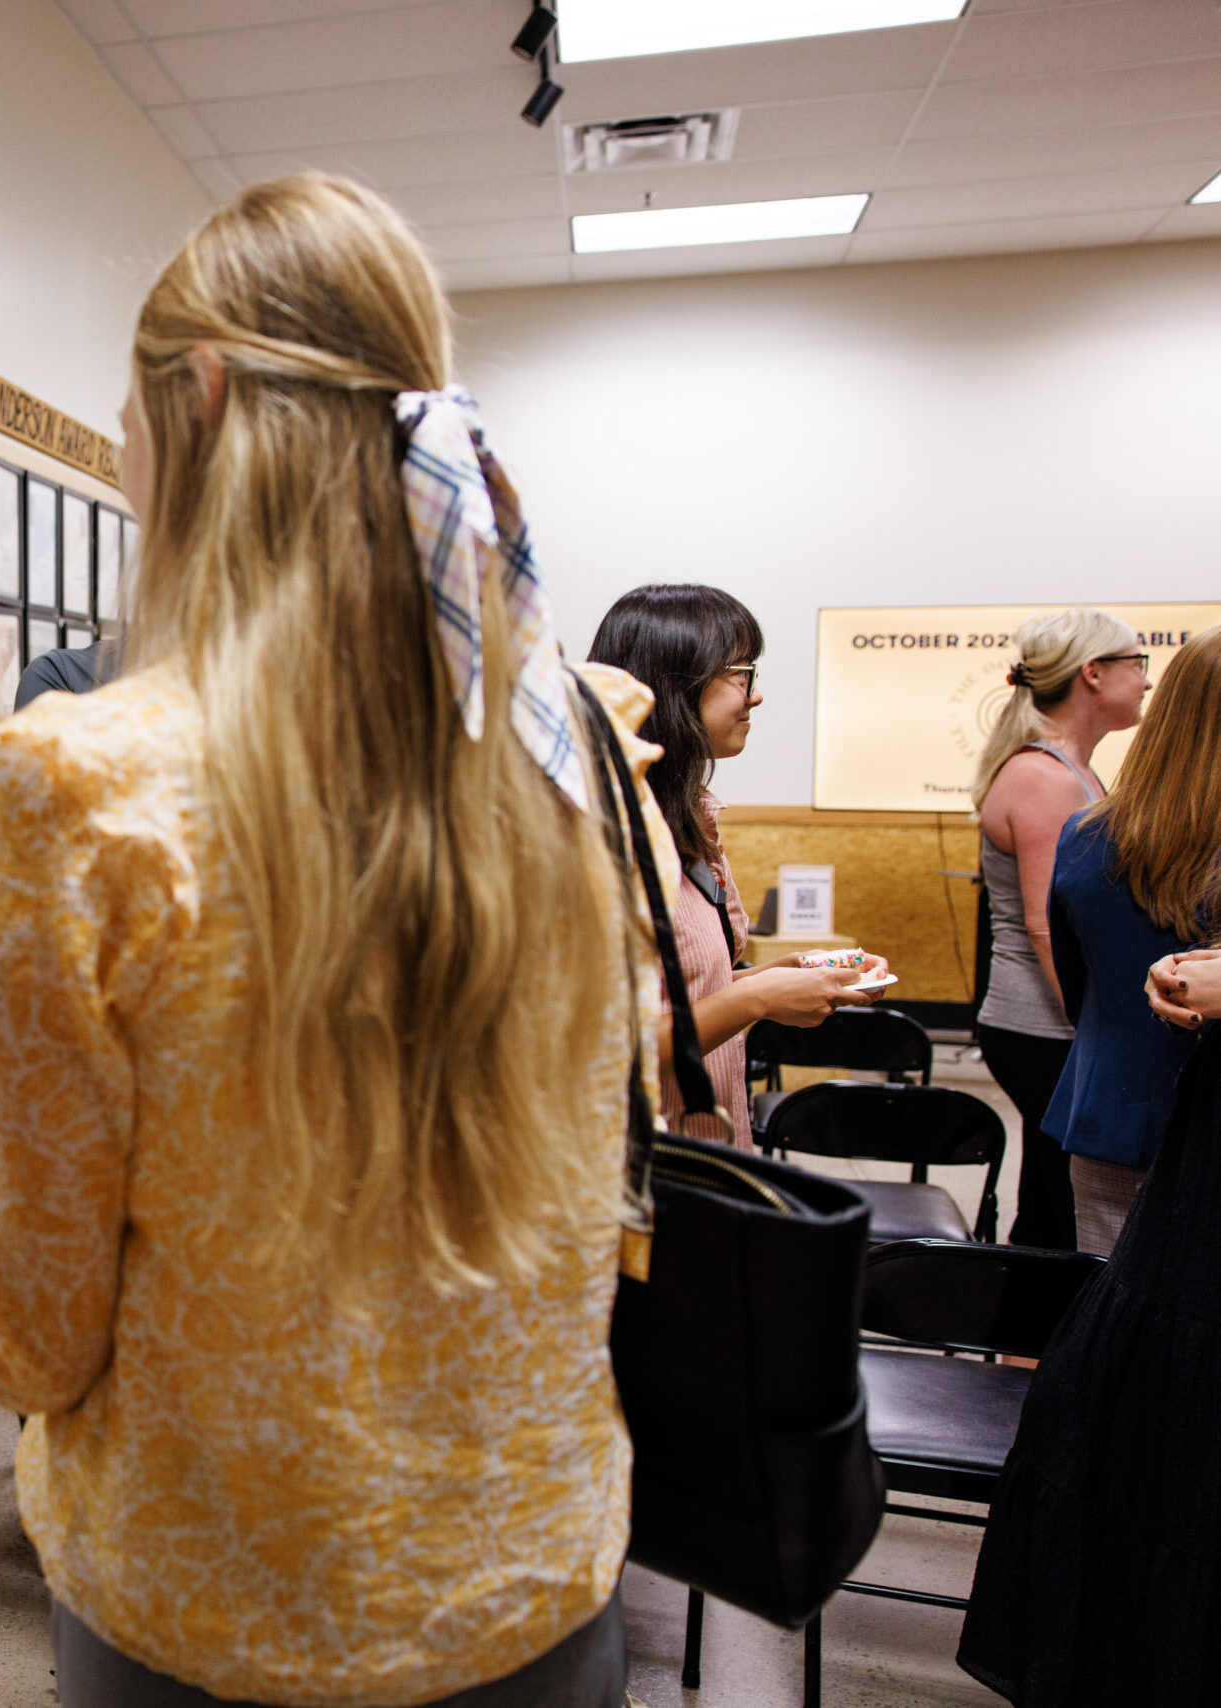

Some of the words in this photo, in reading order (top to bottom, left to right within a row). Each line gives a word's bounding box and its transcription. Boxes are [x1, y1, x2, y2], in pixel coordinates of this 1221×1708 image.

[852, 632, 960, 650] OCTOBER
[967, 632, 1017, 649] 202
[1136, 630, 1191, 647] ABLE
